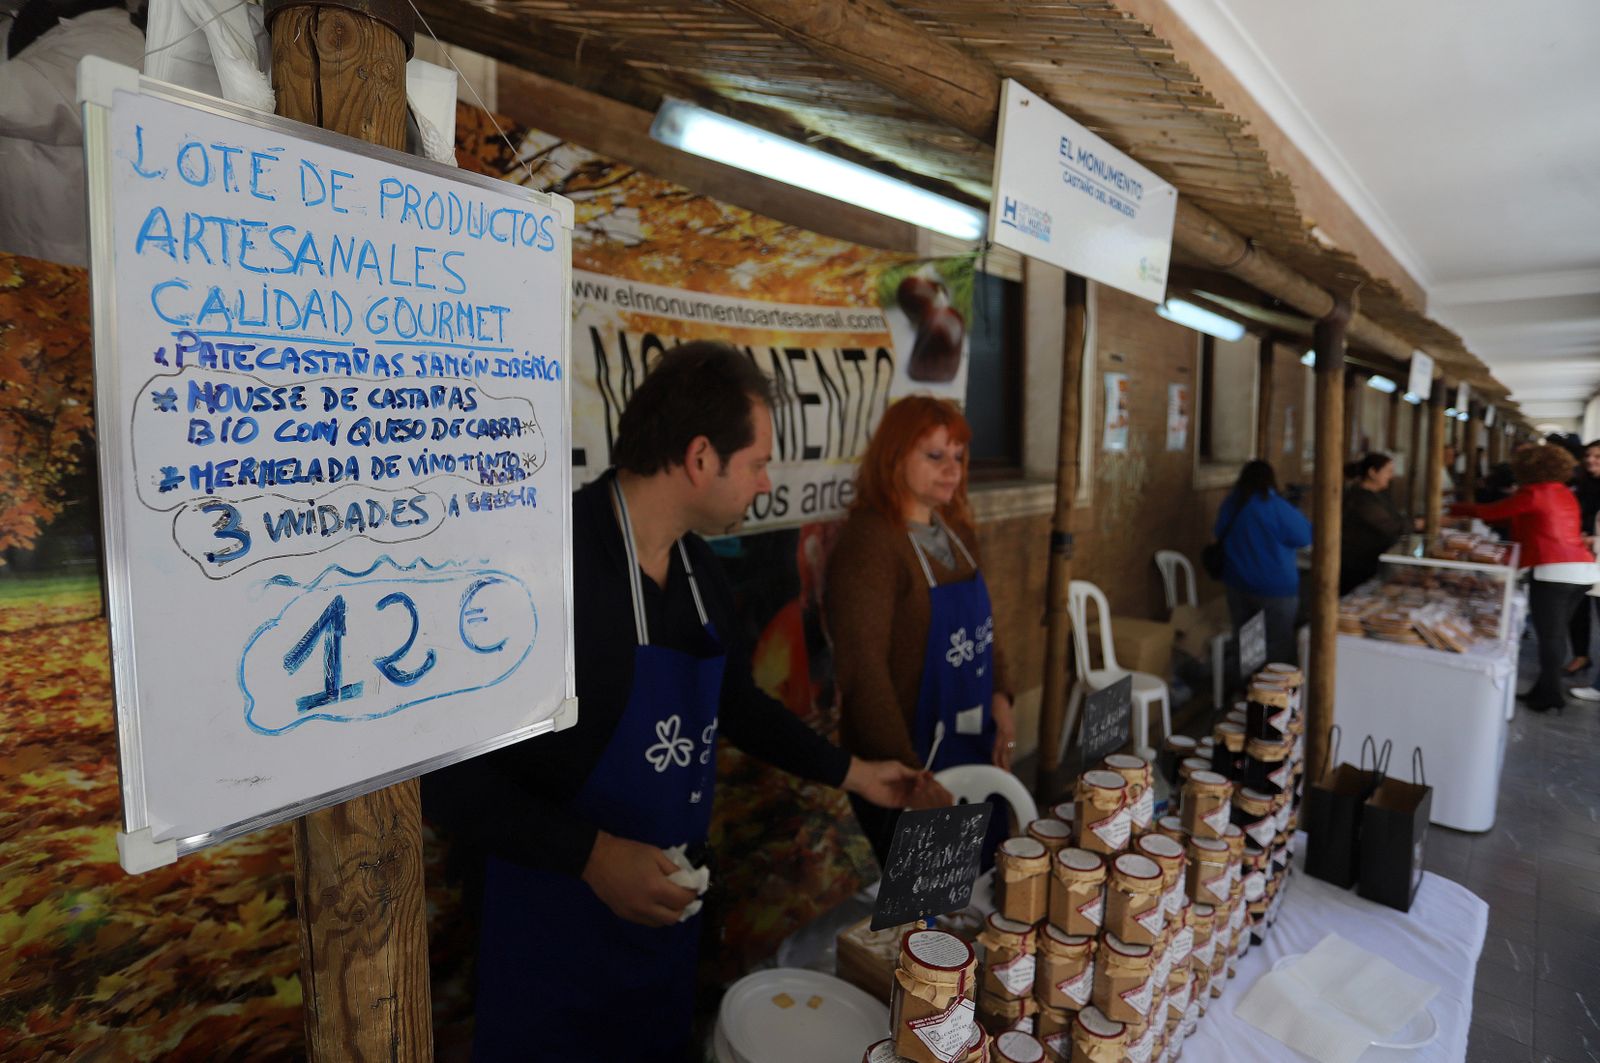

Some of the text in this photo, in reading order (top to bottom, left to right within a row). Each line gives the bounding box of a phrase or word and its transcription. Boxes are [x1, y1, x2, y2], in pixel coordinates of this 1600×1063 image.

[1060, 136, 1144, 200] EL MONUMENTO
[300, 158, 354, 214] DE
[379, 178, 555, 251] PRODUCTOS
[135, 207, 466, 295] ARTESANALES
[150, 279, 511, 342] CALIDAD GOURMET
[187, 379, 307, 414] MOUSSE
[320, 386, 359, 414] DE
[187, 416, 260, 446] BIO
[274, 418, 339, 446] CON
[347, 416, 427, 447] QUESO
[189, 455, 360, 495] MERMELADA
[371, 455, 402, 481] DE
[201, 502, 253, 566] 3
[262, 494, 430, 543] UNIDADES
[449, 493, 460, 518] A
[282, 576, 511, 713] 12 €
